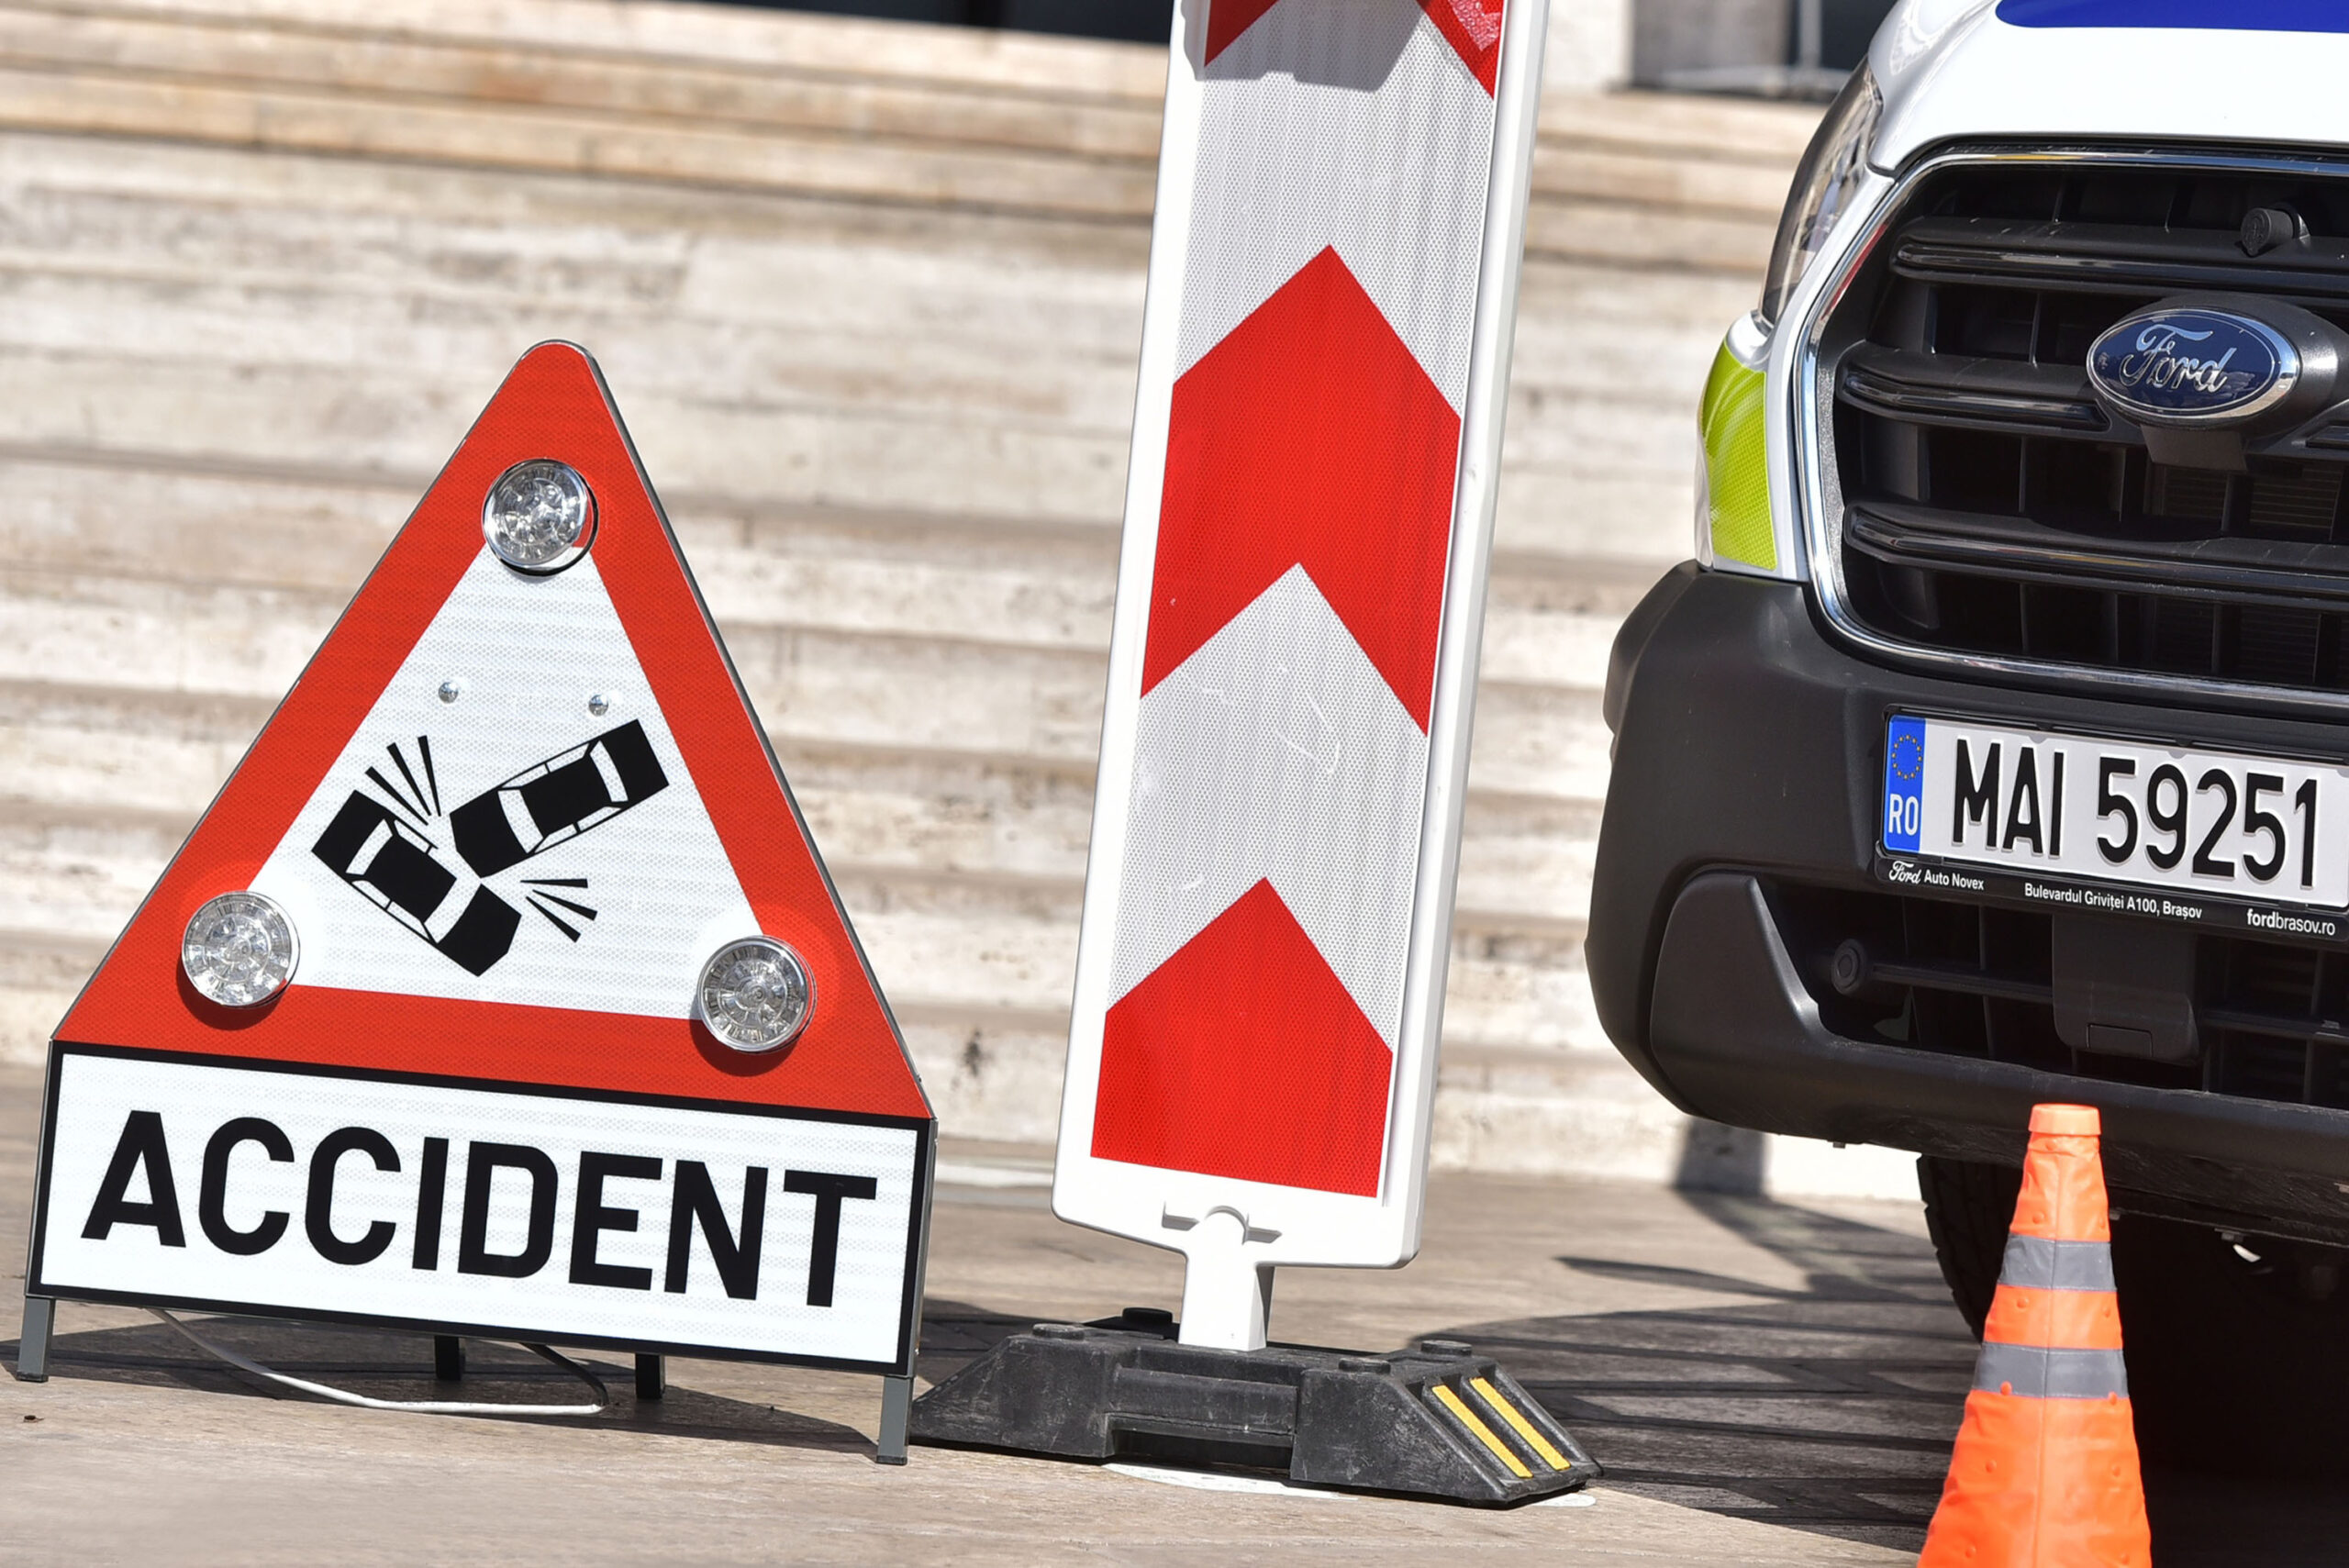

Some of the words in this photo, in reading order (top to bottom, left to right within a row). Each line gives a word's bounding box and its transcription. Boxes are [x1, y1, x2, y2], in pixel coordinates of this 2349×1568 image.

[2119, 324, 2237, 393] Ford
[1888, 794, 1919, 836] RO
[1952, 739, 2065, 858] MAI
[2096, 756, 2318, 891] 59251
[1888, 861, 1922, 884] Ford
[1924, 870, 1949, 885] Auto
[1952, 873, 1985, 890] Novex
[2024, 882, 2082, 903] Bulevardul
[2126, 895, 2160, 917] A100,
[2247, 907, 2336, 936] fordbrasov.ro
[81, 1110, 876, 1308] ACCIDENT
